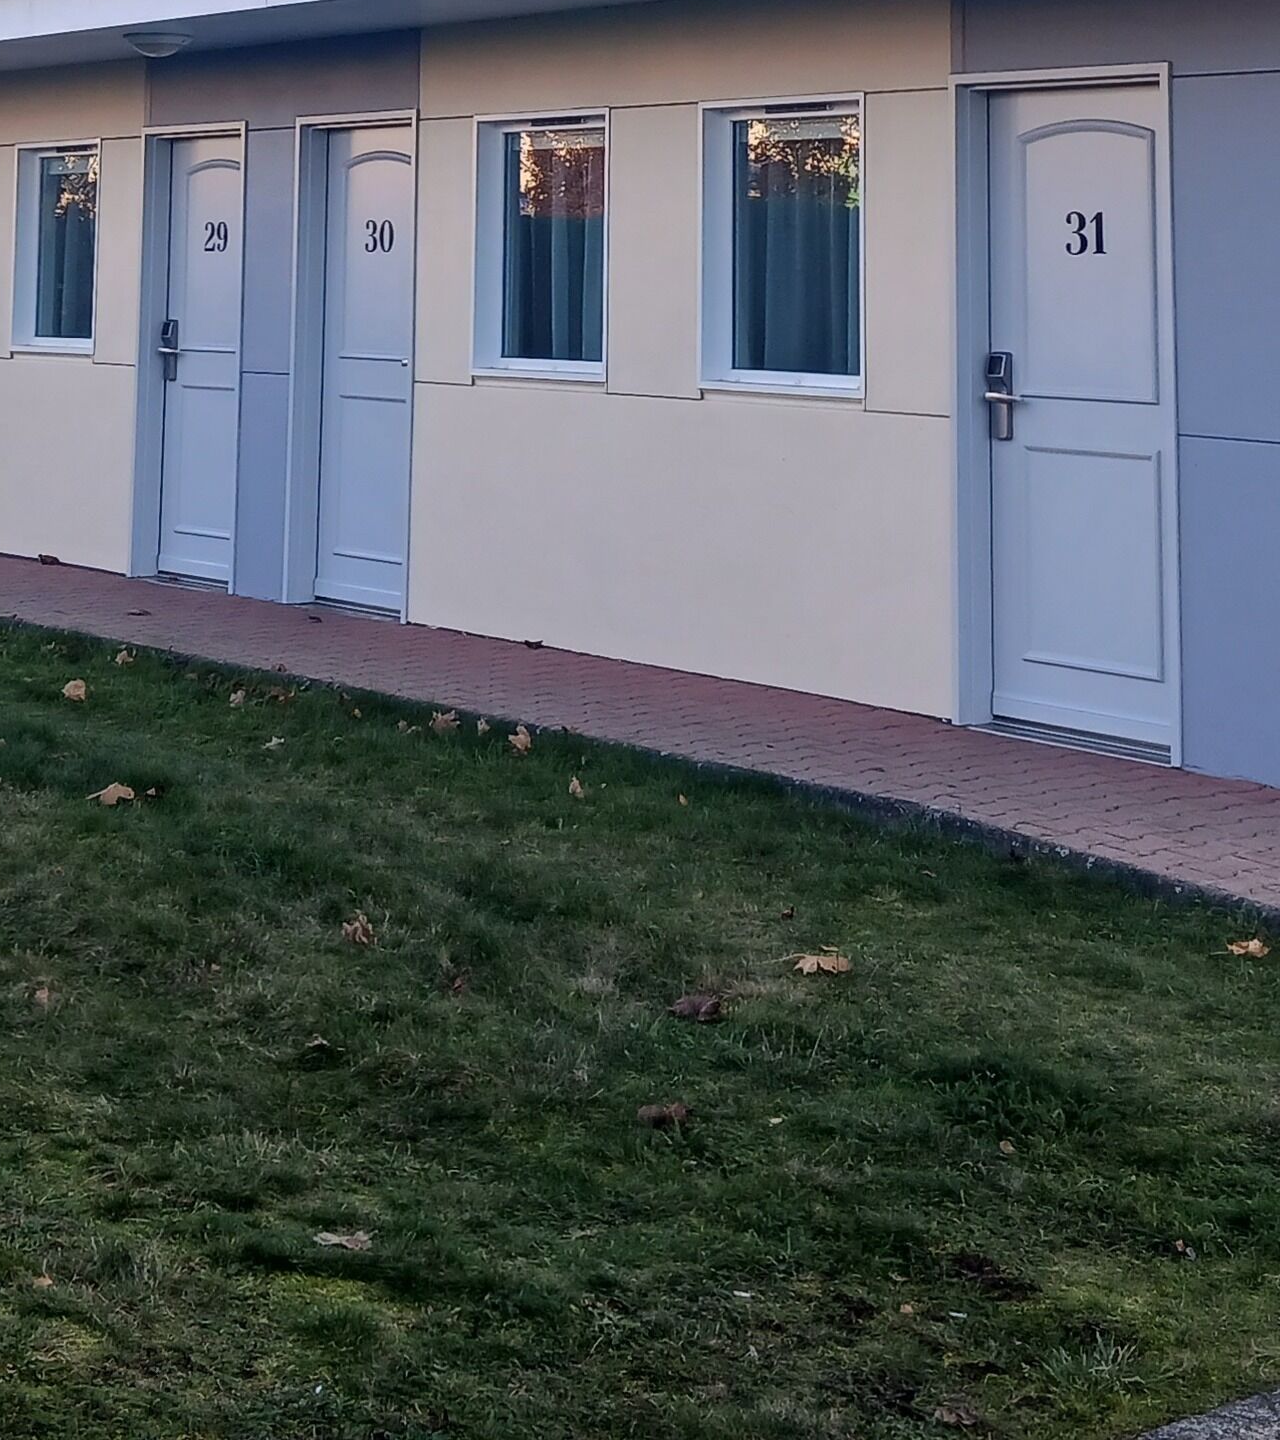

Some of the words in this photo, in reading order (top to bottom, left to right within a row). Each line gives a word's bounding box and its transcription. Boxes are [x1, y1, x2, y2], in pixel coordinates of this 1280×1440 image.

[204, 221, 228, 252] 29
[365, 220, 394, 253] 30
[1066, 211, 1107, 256] 31
